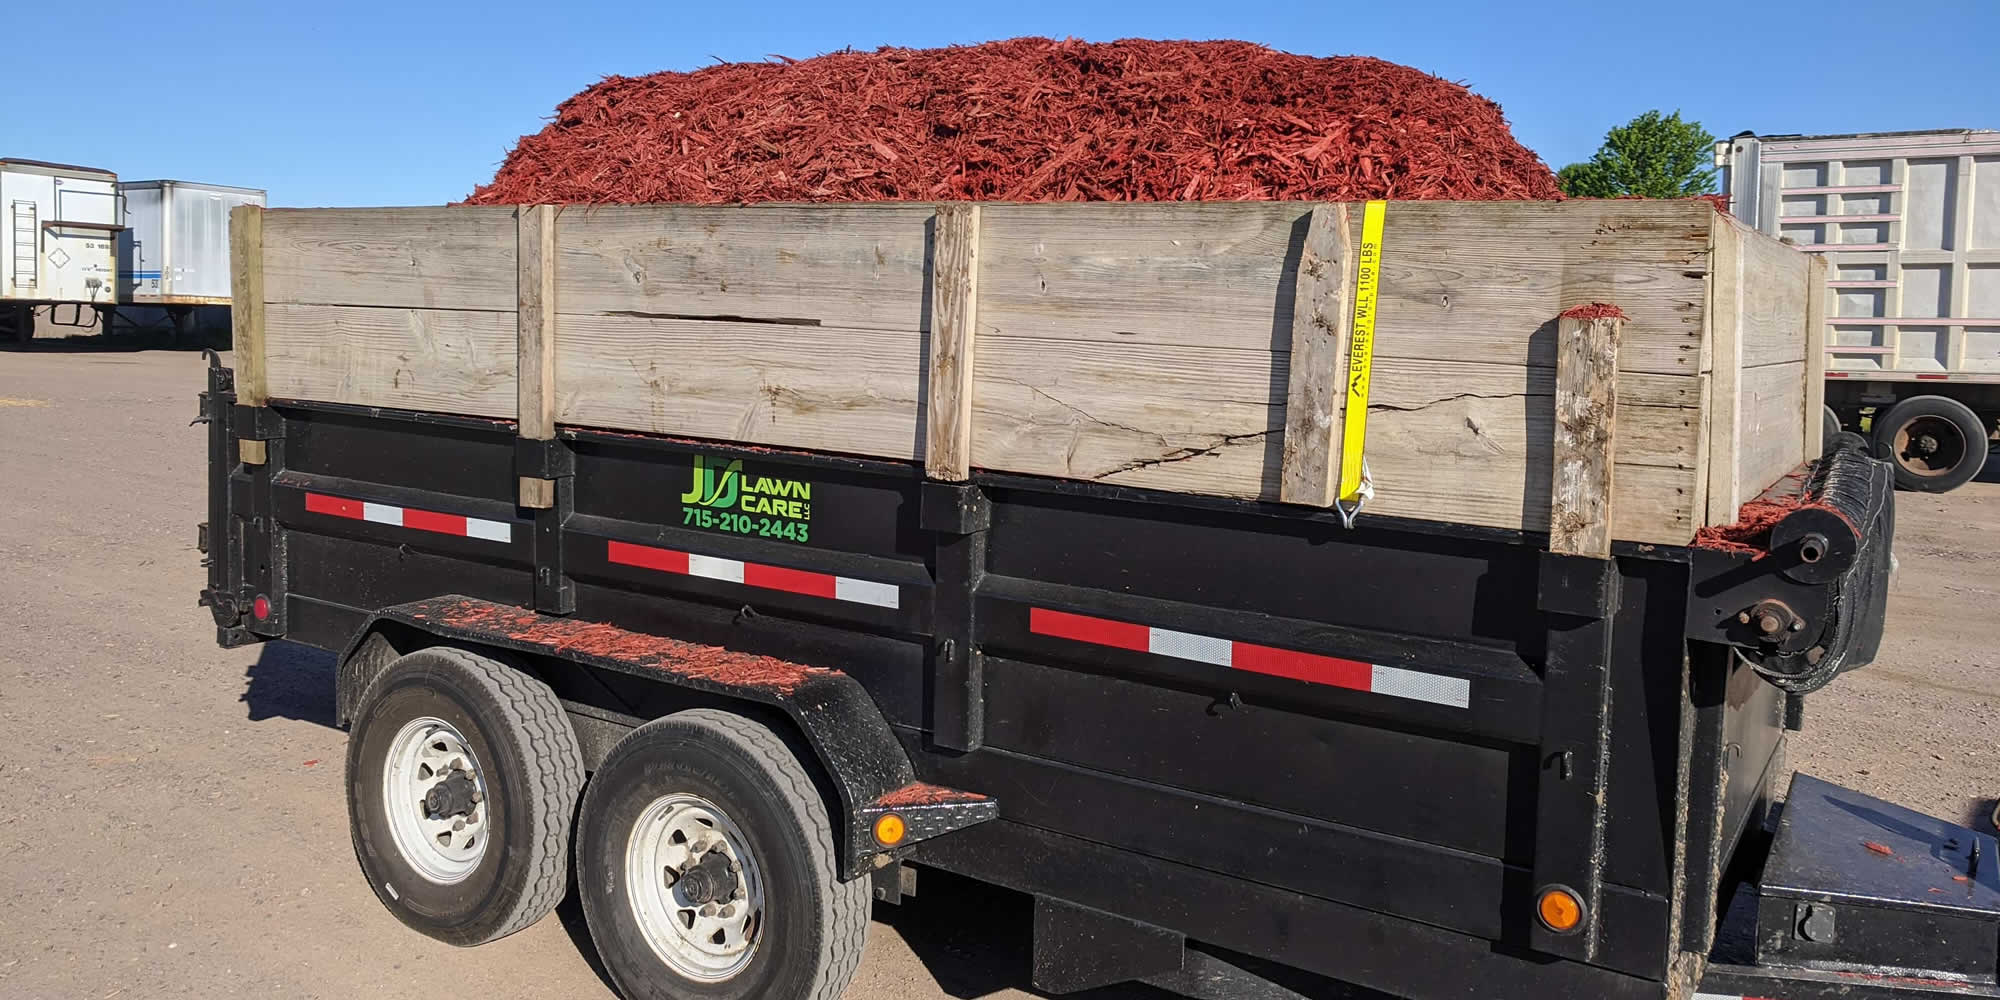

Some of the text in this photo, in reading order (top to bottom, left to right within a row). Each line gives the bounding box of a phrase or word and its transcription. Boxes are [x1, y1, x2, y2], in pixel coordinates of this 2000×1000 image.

[1352, 242, 1374, 372] EVEREST WLL 1100 LBS
[741, 475, 811, 500] LAWN
[741, 495, 802, 519] CARE
[682, 507, 809, 543] 715-210-2443
